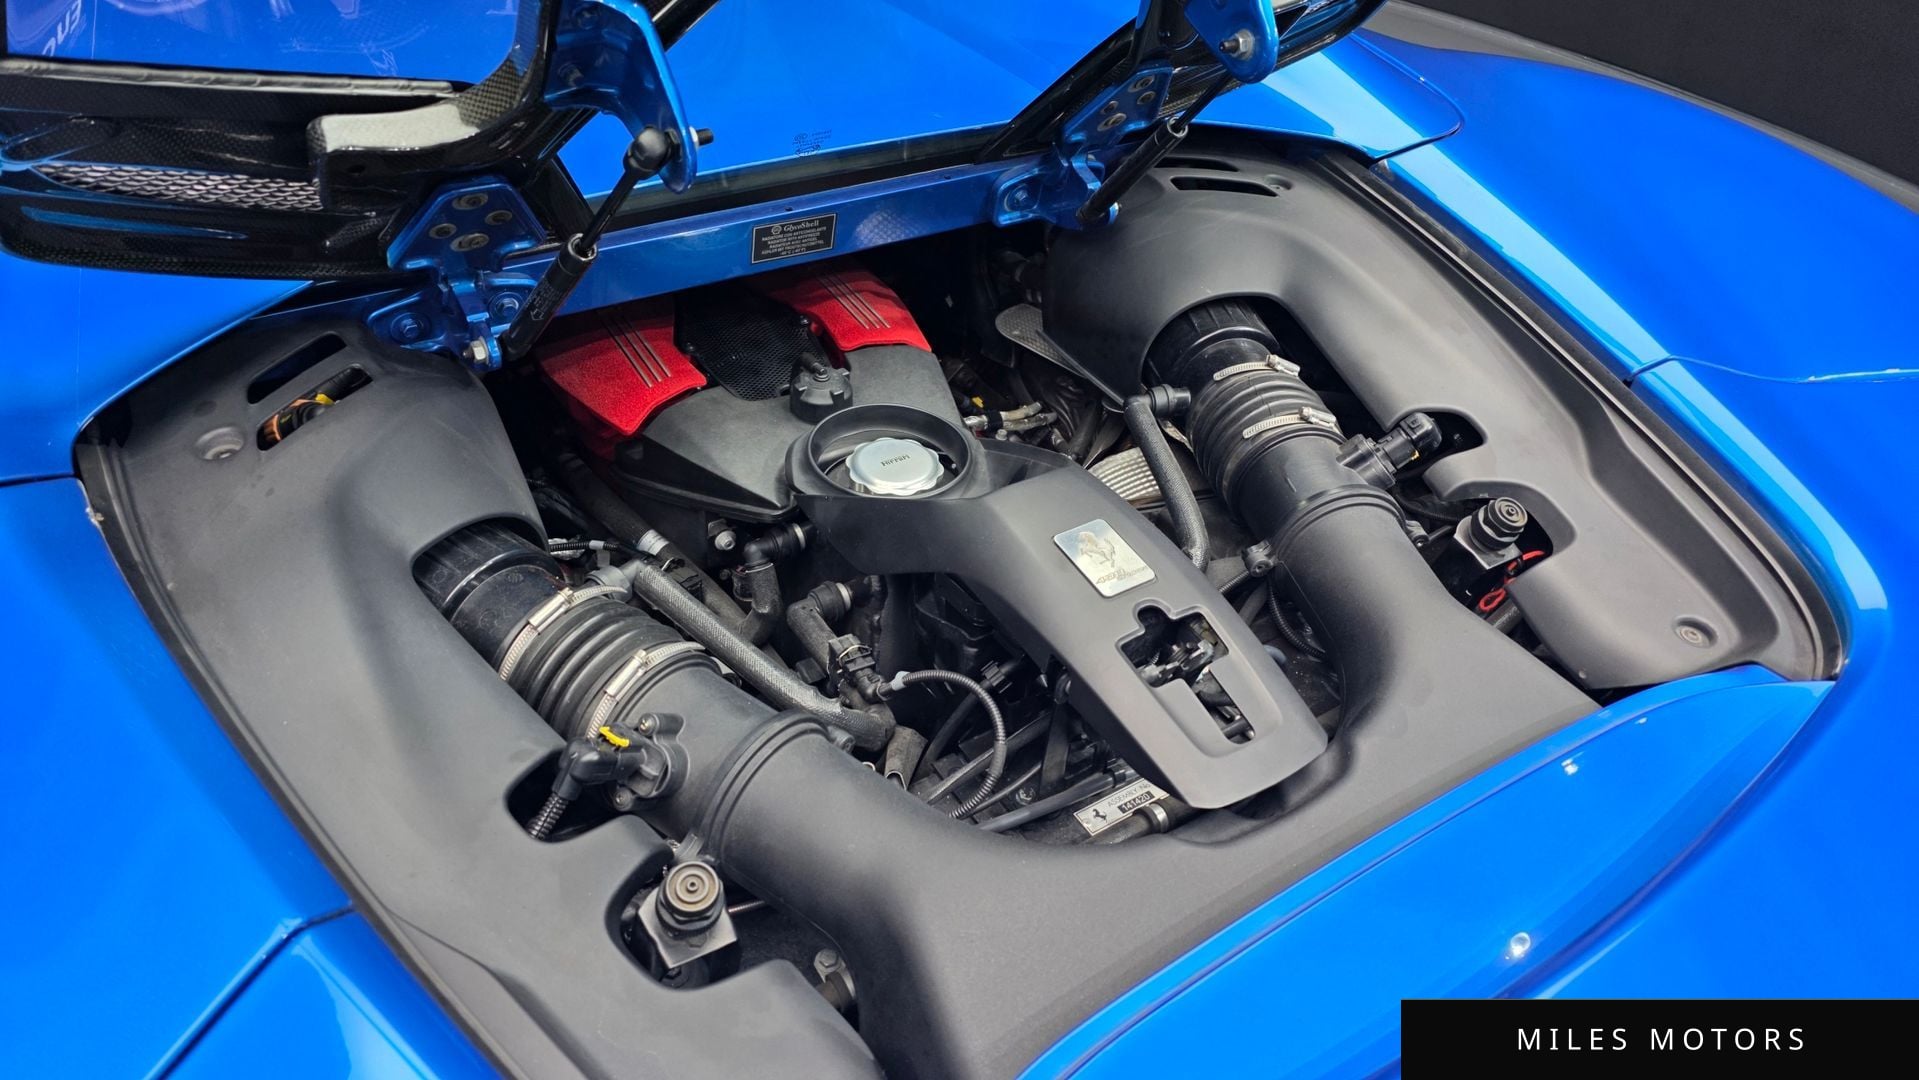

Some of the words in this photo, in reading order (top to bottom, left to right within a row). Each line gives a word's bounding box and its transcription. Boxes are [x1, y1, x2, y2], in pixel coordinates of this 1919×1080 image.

[784, 220, 819, 231] GlycoShell
[1107, 788, 1138, 807] ASSEMBLY
[1121, 793, 1150, 811] 141420
